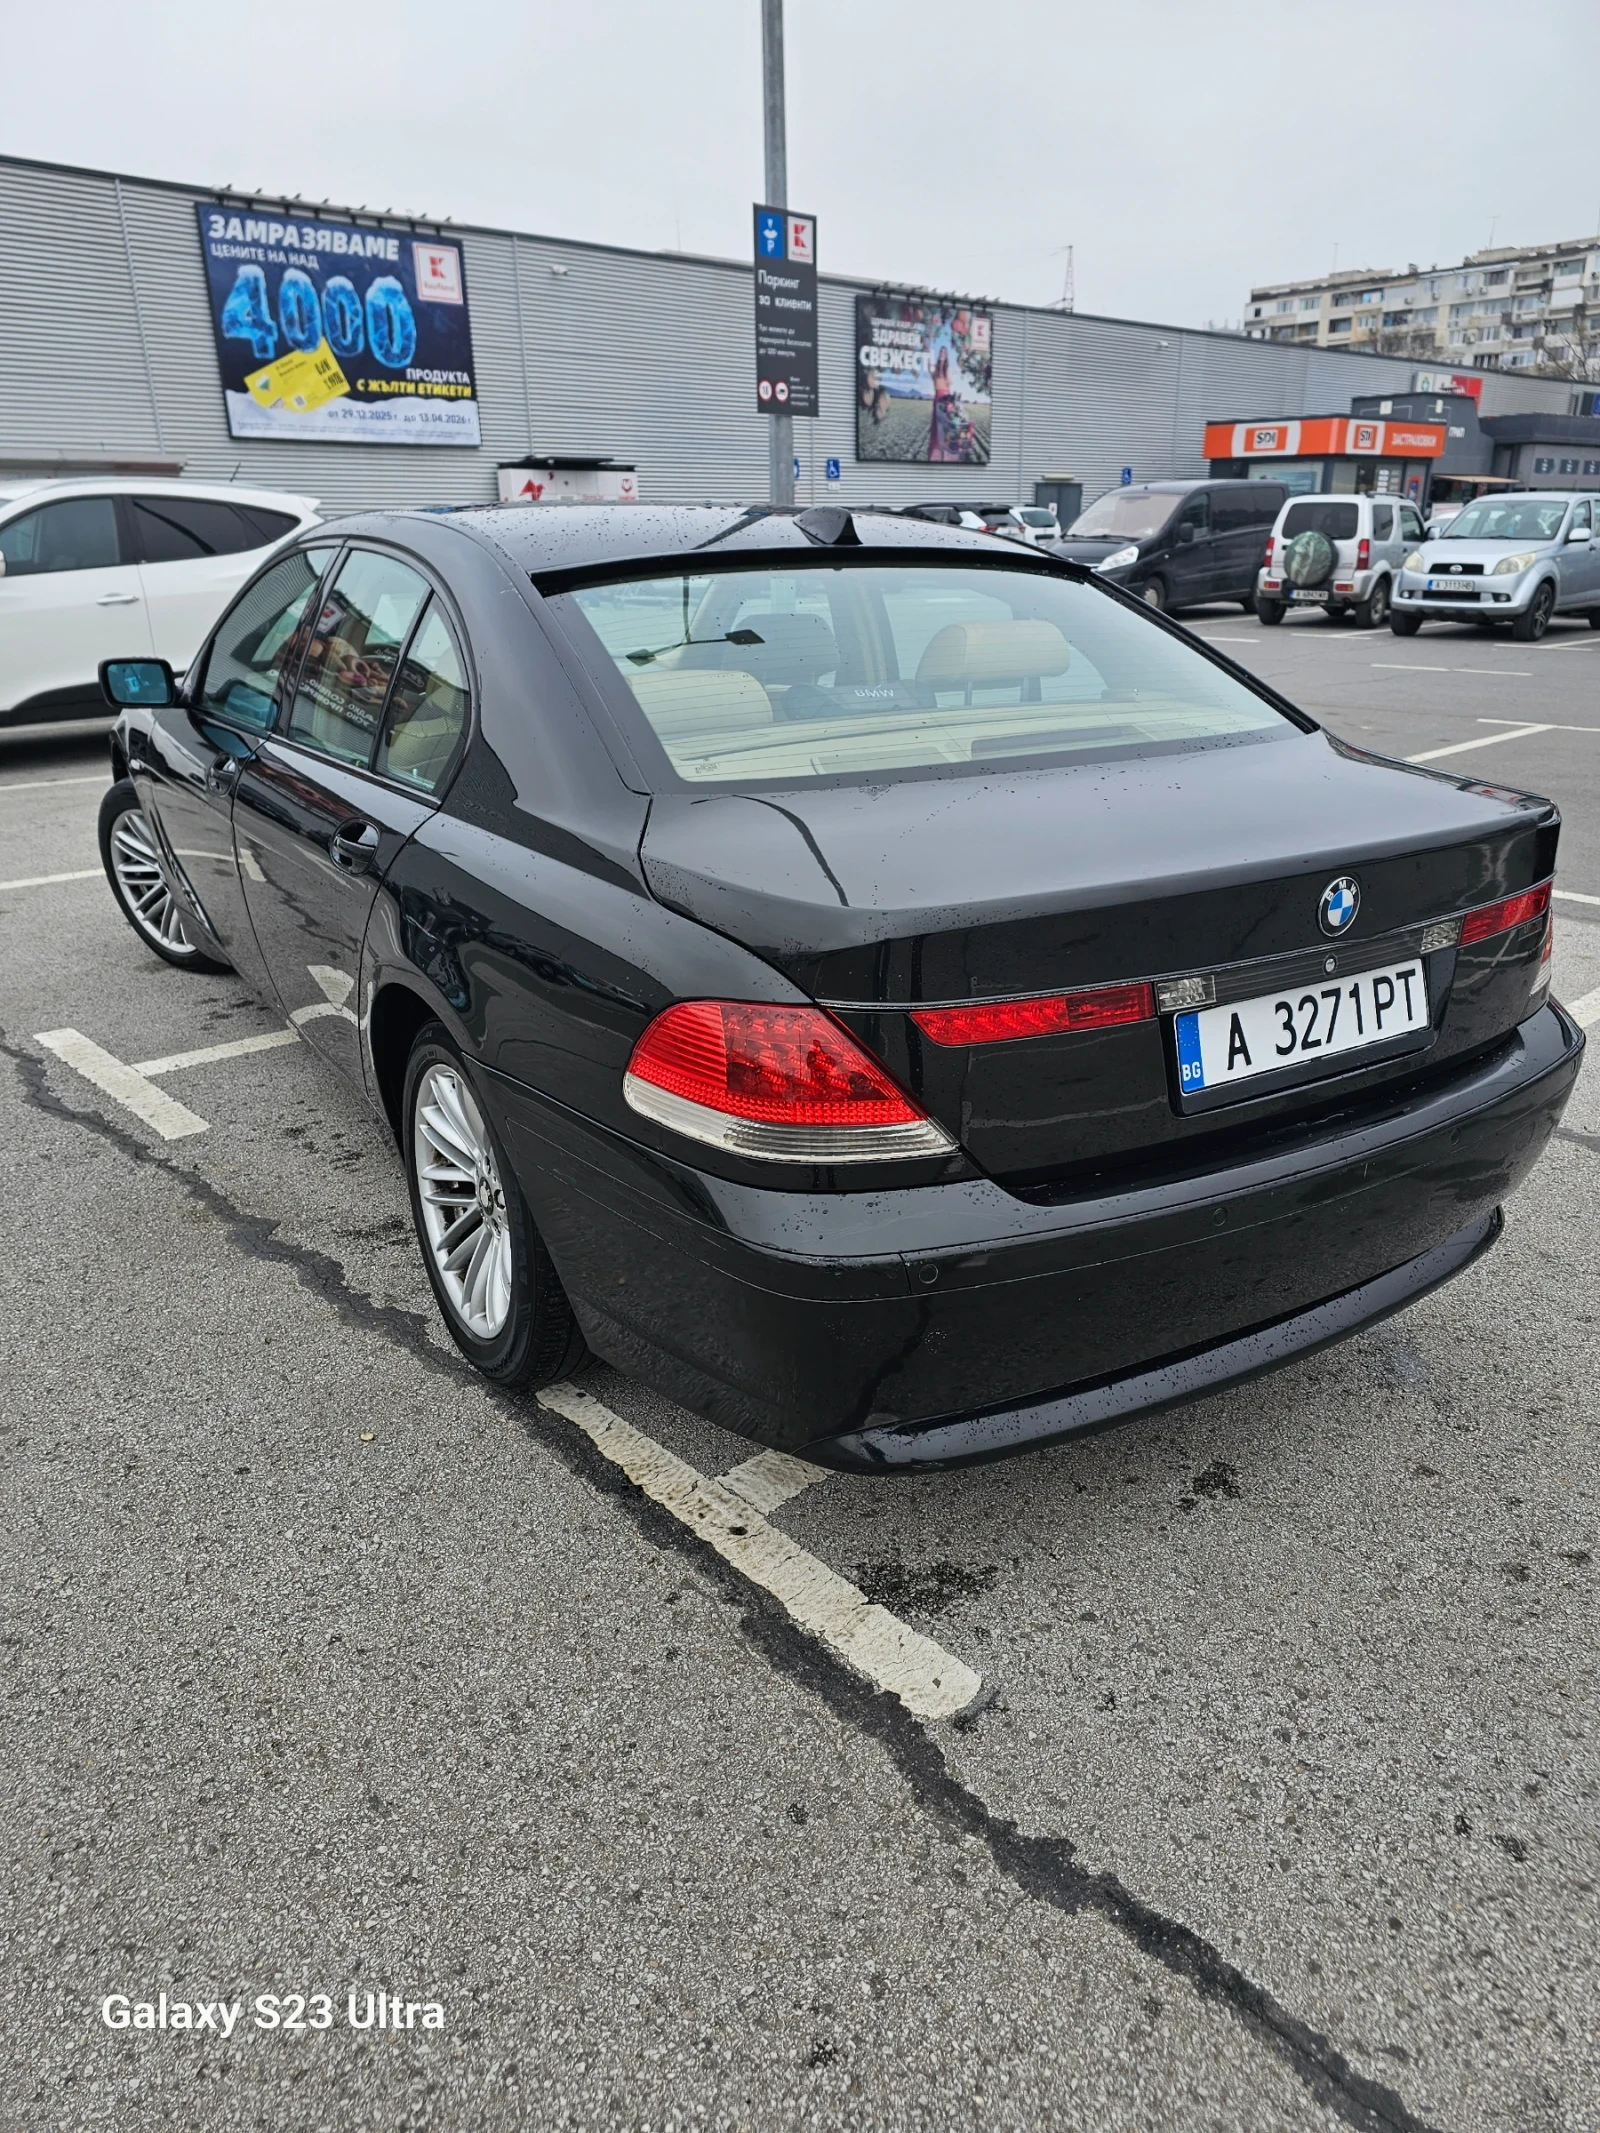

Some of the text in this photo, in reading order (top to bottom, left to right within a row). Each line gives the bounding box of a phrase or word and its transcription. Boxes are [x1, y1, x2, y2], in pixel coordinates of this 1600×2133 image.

[209, 215, 399, 261] ЗАМРАЗЯВАМЕ
[210, 243, 319, 269] ЦЕНИТЕ НА НАД
[758, 269, 800, 290] Паркинг
[758, 296, 812, 312] за клиенти
[222, 264, 416, 368] 4000
[405, 367, 471, 385] ПРОДУКТА
[356, 379, 472, 398] С ЖЪЛТИ ЕТИКЕТИ
[1256, 431, 1277, 444] SDI
[854, 689, 894, 697] BMW
[1326, 880, 1357, 901] BMW
[1227, 968, 1416, 1070] A 3271PT
[1181, 1061, 1201, 1081] BG
